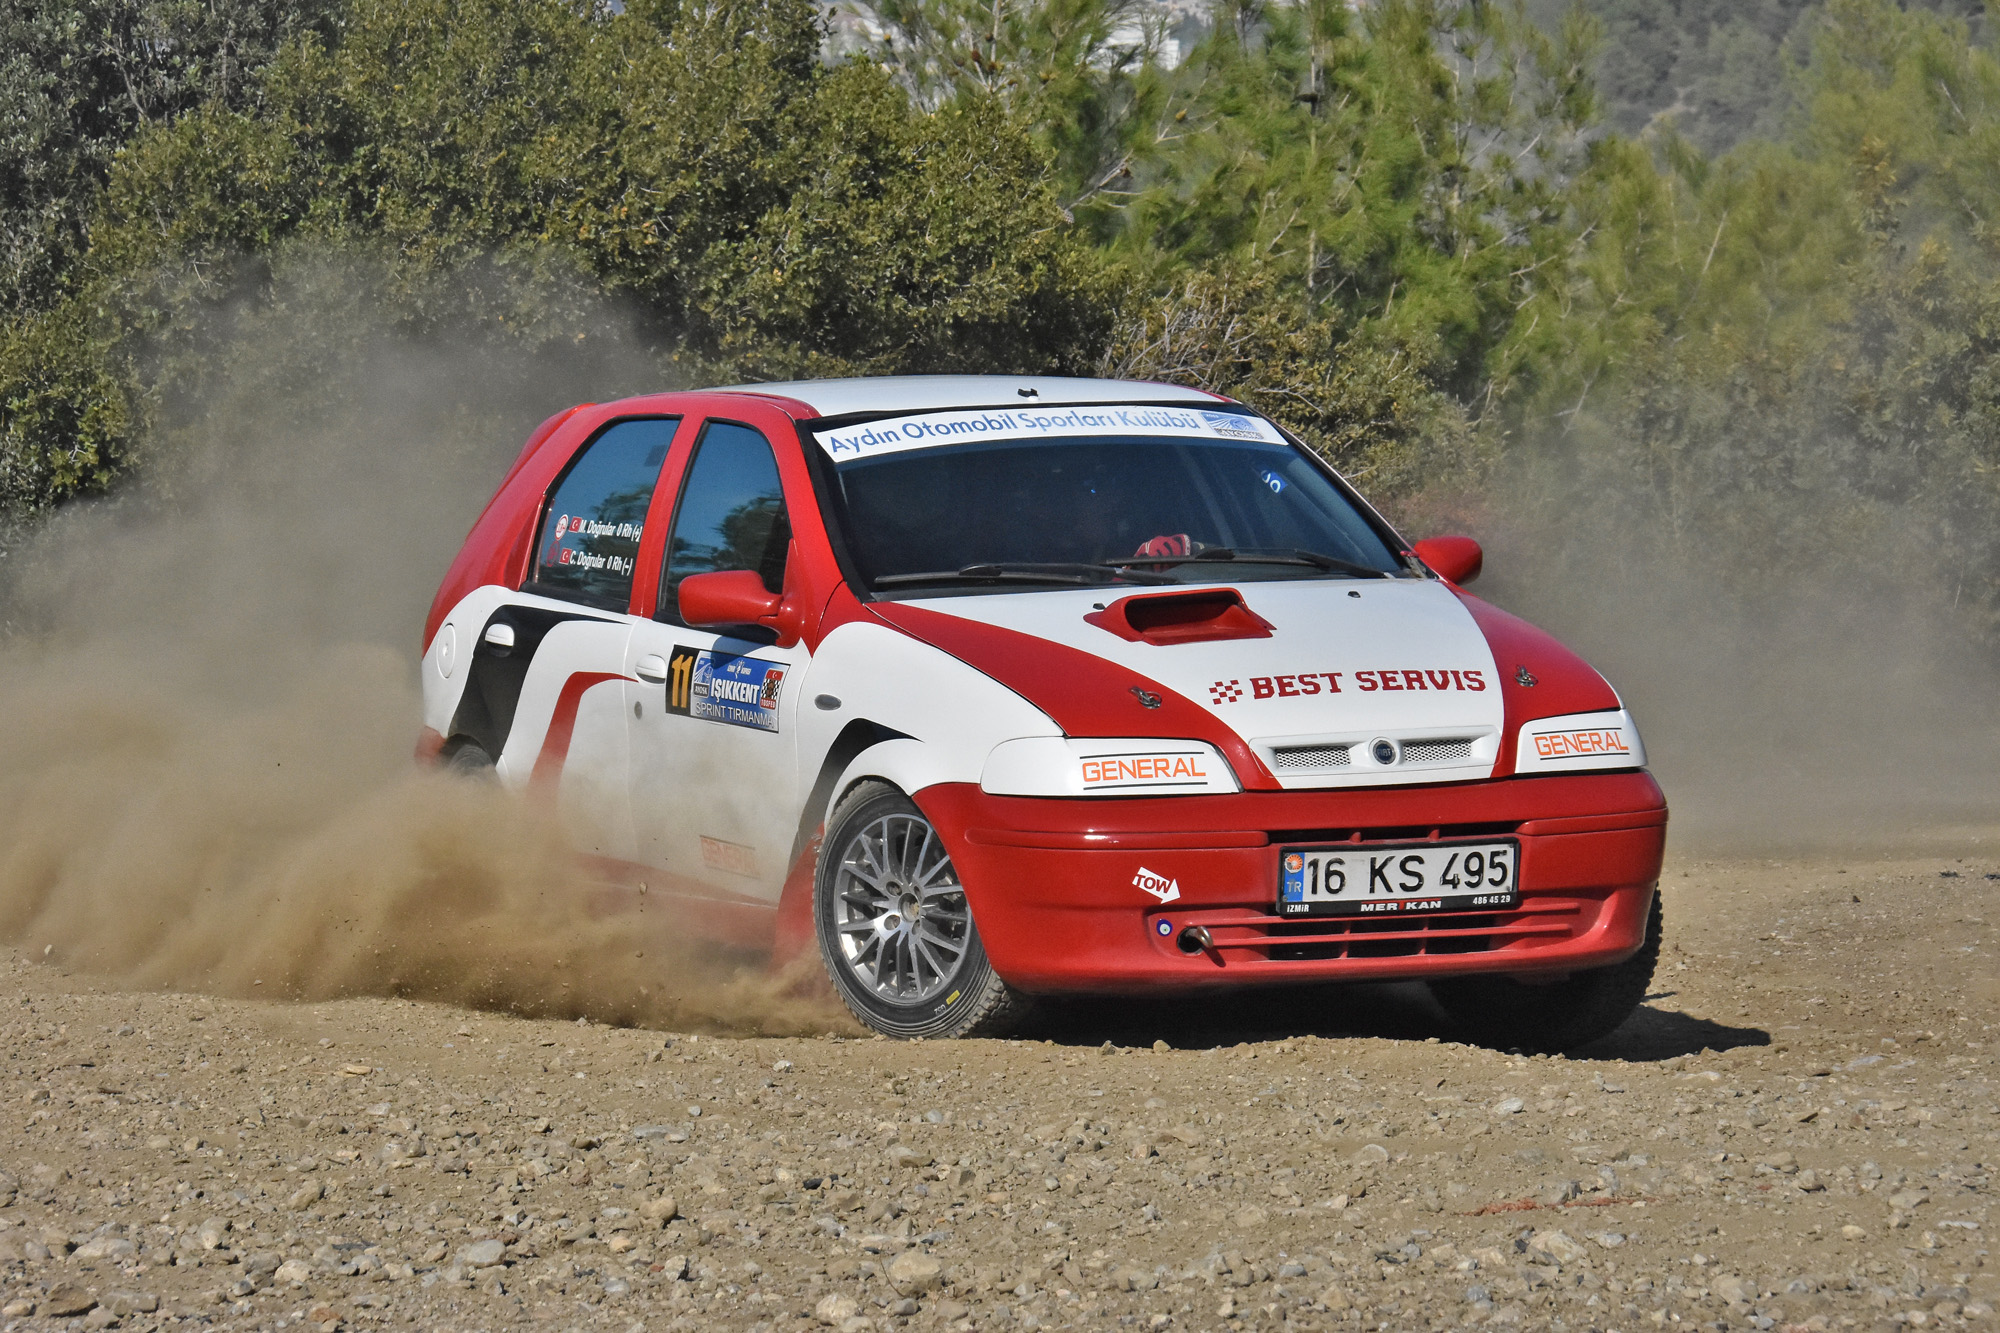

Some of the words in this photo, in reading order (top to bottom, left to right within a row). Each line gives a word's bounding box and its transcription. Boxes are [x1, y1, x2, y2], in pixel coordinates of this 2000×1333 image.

[831, 430, 901, 453] Aydın
[902, 413, 1018, 440] Otomobil
[1019, 411, 1116, 432] Sporları
[1115, 411, 1201, 430] Kulübü
[580, 519, 587, 533] M.
[587, 520, 616, 538] Doğrular
[622, 523, 632, 537] Rh
[631, 525, 643, 542] (+)
[570, 550, 577, 565] C.
[577, 551, 606, 570] Doğrular
[612, 556, 623, 571] Rh
[621, 557, 634, 576] (-)
[672, 654, 693, 708] 11
[710, 678, 760, 703] IŞIKKENT
[1250, 672, 1343, 700] BEST
[1355, 670, 1486, 692] SERVIS
[695, 702, 726, 718] SPRINT
[1534, 731, 1629, 756] GENERAL
[1082, 757, 1206, 782] GENERAL
[1135, 874, 1172, 894] TOW
[1307, 857, 1346, 895] 16
[1369, 855, 1425, 894] KS
[1439, 851, 1509, 889] 495
[1287, 881, 1302, 893] TR
[1489, 896, 1500, 904] 45
